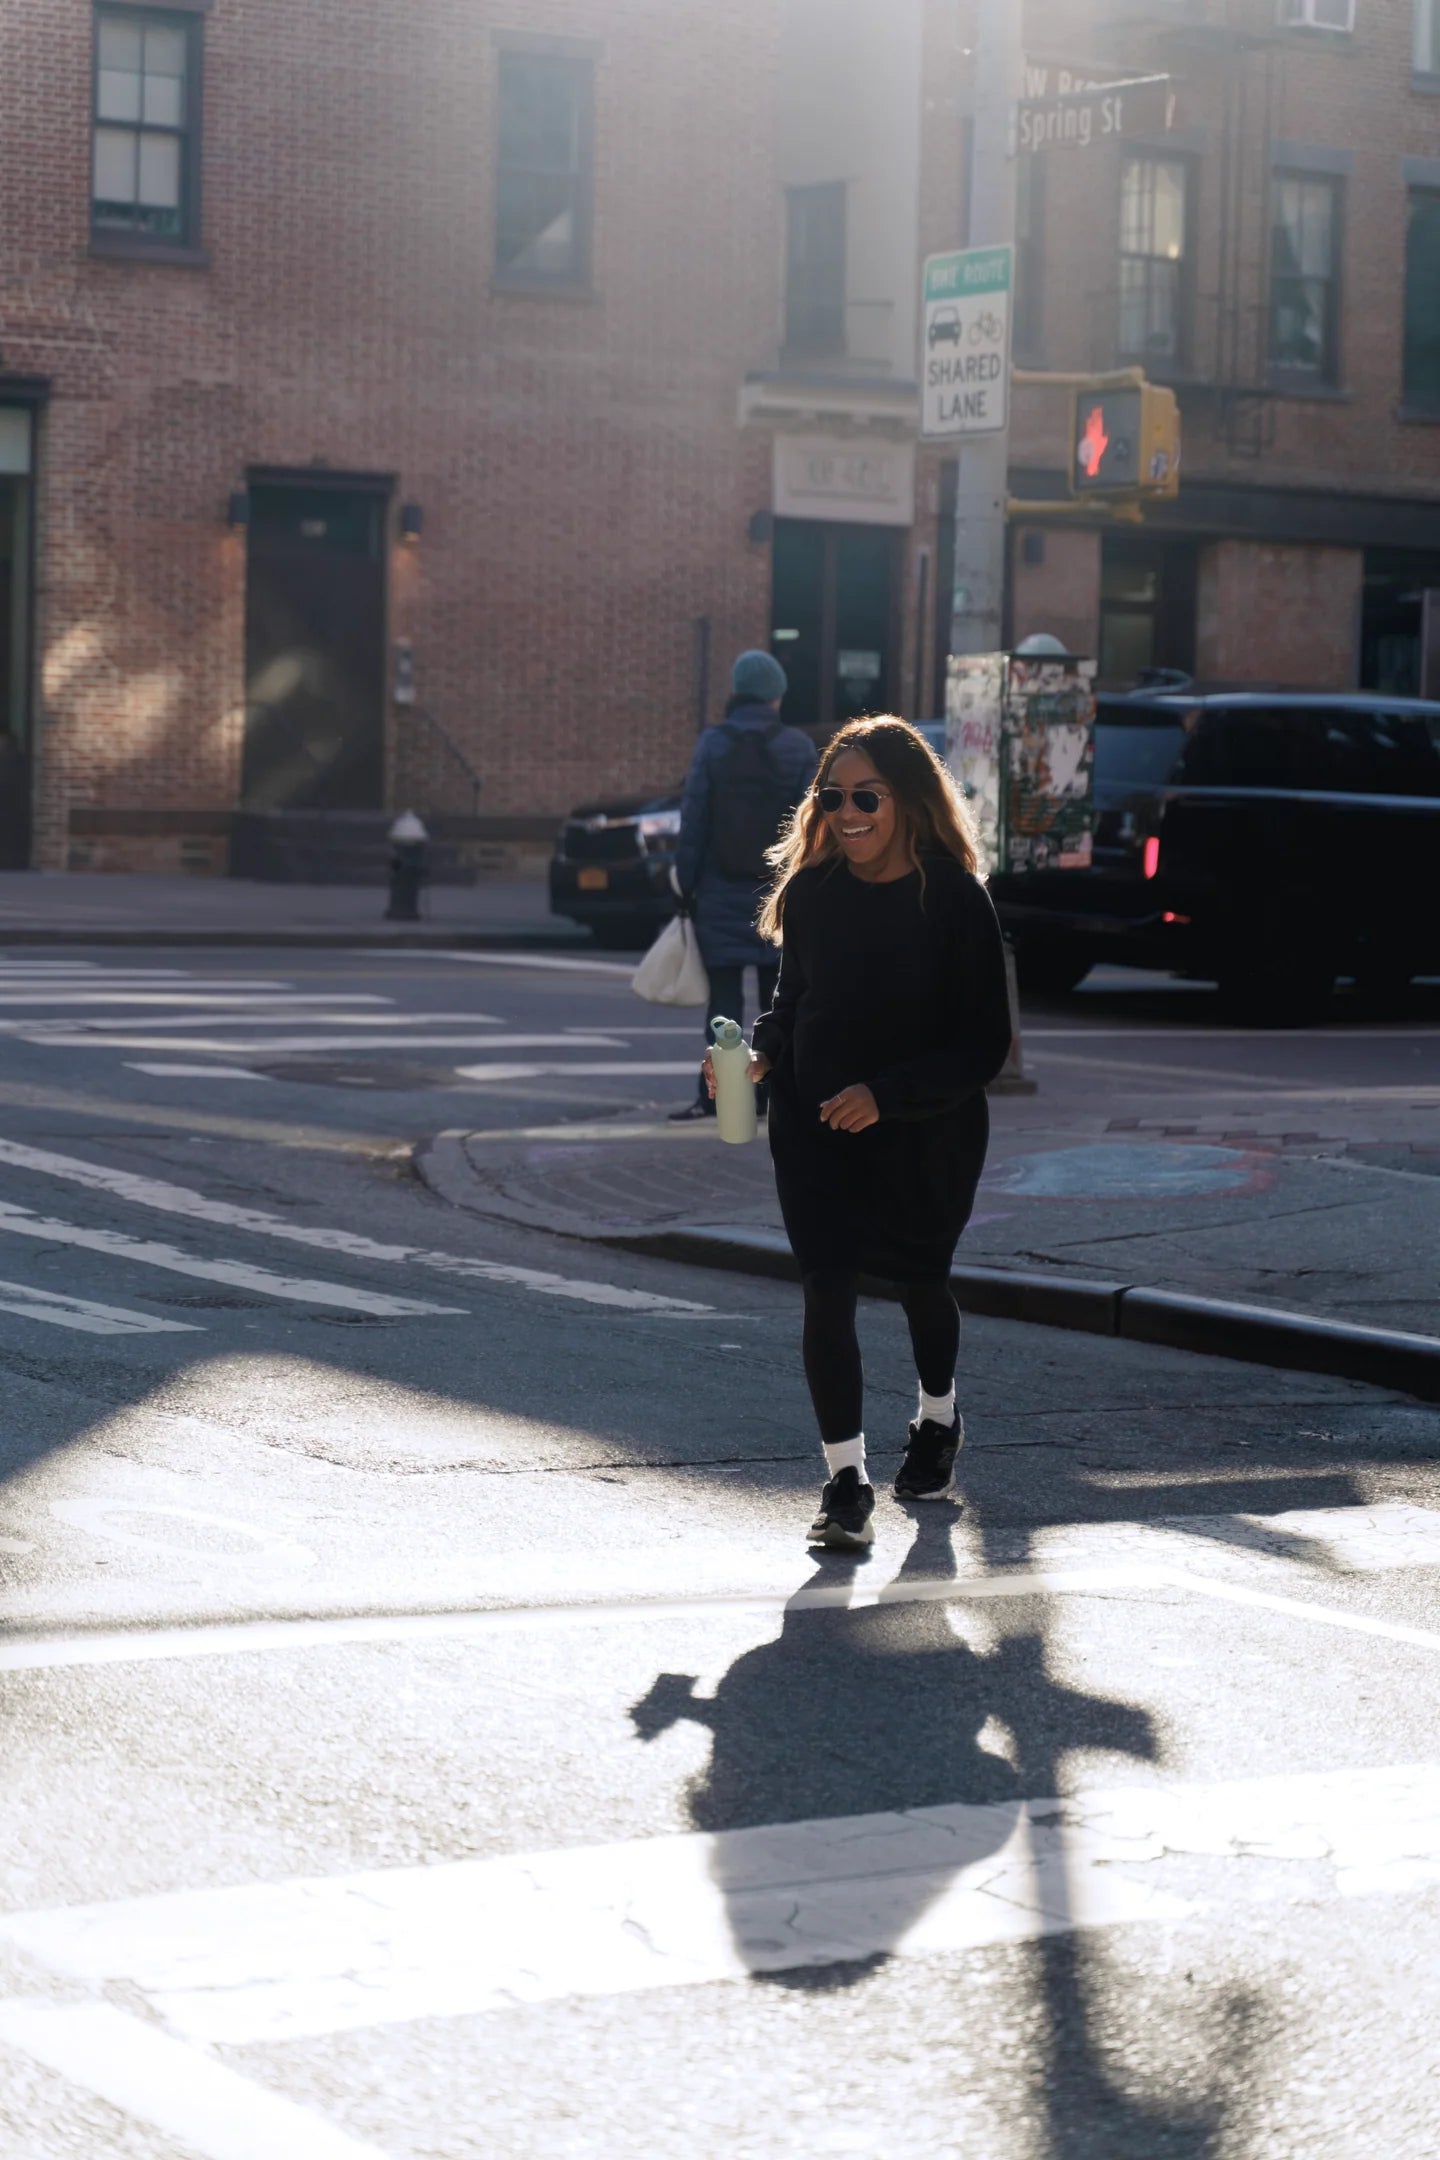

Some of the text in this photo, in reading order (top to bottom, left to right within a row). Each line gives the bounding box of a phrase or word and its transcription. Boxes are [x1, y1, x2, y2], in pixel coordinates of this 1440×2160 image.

[1020, 95, 1123, 151] Spring St
[963, 257, 1006, 284] ROUTE
[928, 354, 1000, 386] SHARED
[938, 391, 988, 421] LANE
